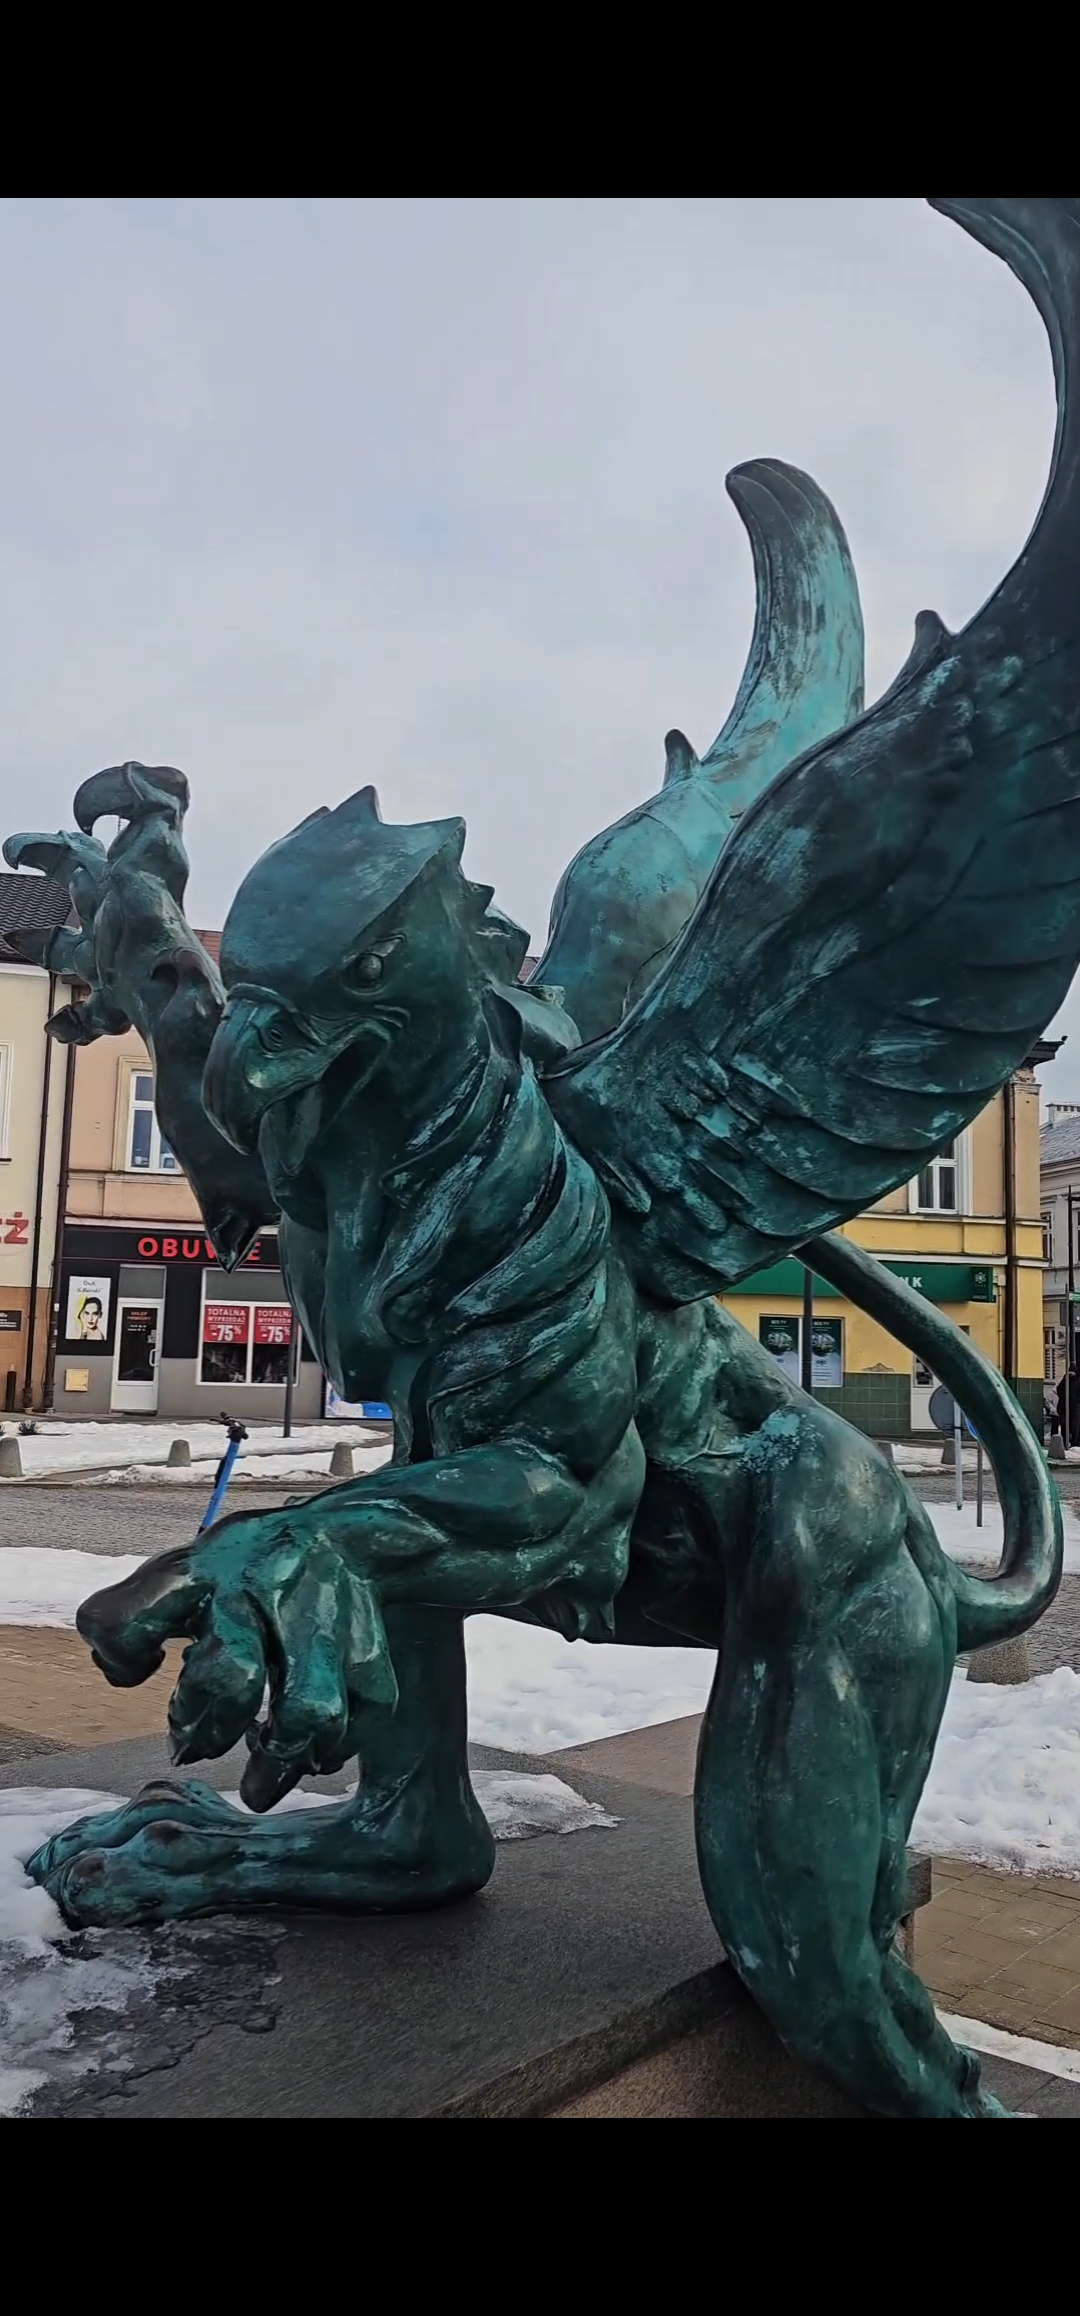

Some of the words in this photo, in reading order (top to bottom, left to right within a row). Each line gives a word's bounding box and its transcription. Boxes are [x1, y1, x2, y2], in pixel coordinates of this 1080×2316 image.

[0, 1212, 29, 1244] Ż
[138, 1237, 261, 1260] OBUE
[899, 1276, 922, 1287] NK
[207, 1308, 246, 1316] TOTALNA
